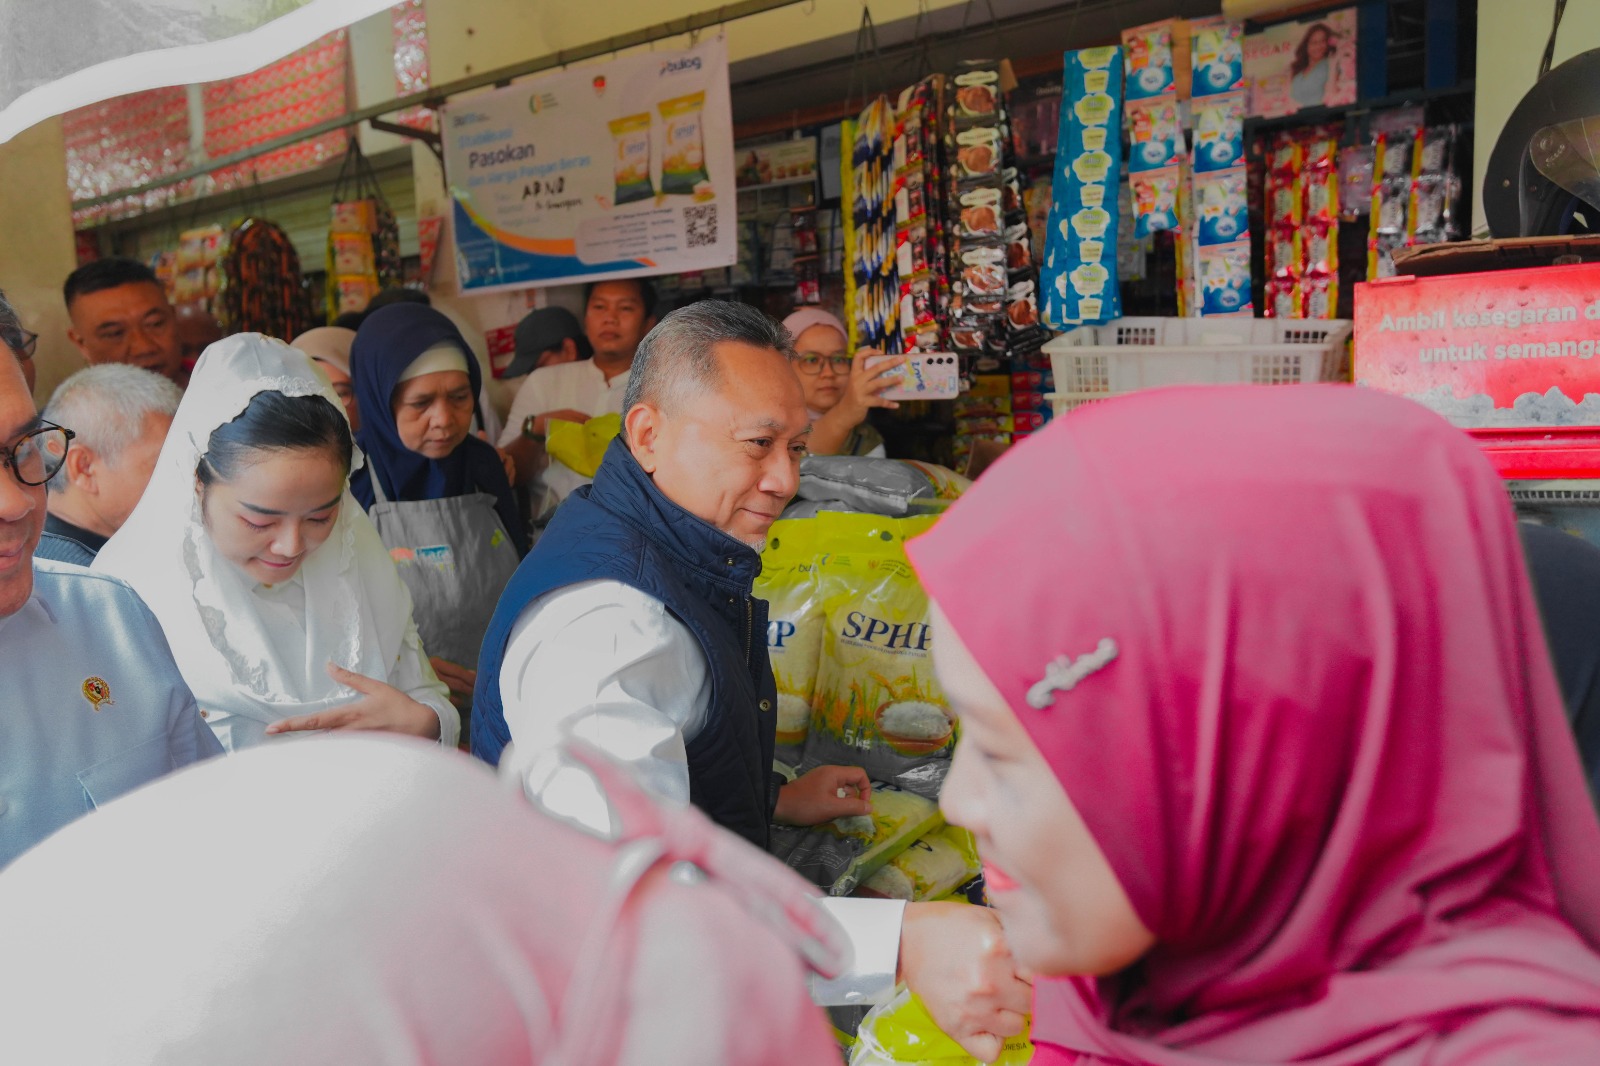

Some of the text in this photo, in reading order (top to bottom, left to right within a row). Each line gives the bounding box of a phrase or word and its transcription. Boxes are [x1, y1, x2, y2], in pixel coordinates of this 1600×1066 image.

[469, 144, 535, 169] Pasokan
[1379, 311, 1446, 332] Ambil
[1452, 306, 1576, 328] kesegaran
[1419, 342, 1487, 363] untuk
[844, 729, 871, 749] 5 kg
